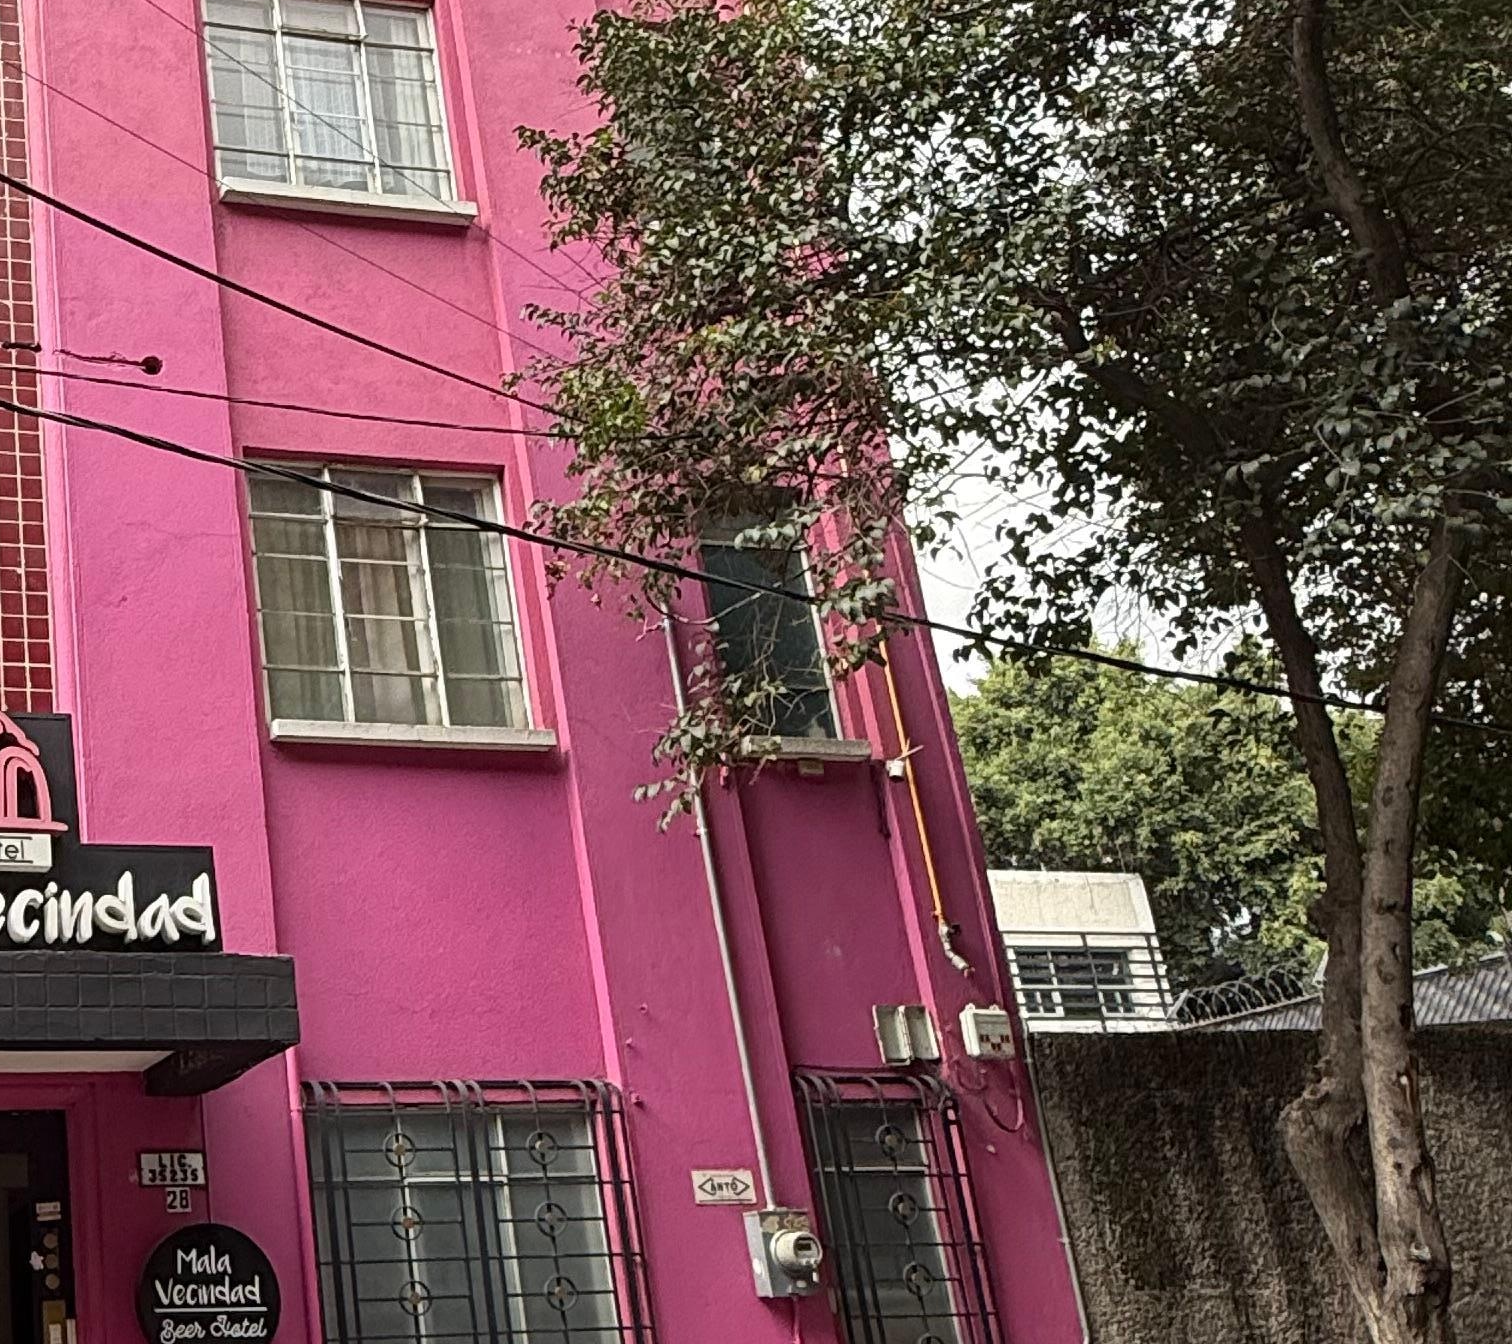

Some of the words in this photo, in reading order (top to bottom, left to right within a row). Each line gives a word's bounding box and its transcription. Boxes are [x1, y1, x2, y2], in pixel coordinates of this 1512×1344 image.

[158, 1153, 192, 1169] LIC.
[167, 1189, 190, 1210] 28
[176, 1244, 233, 1275] Mala
[154, 1274, 262, 1306] Vecindad
[209, 1314, 268, 1339] Hotel
